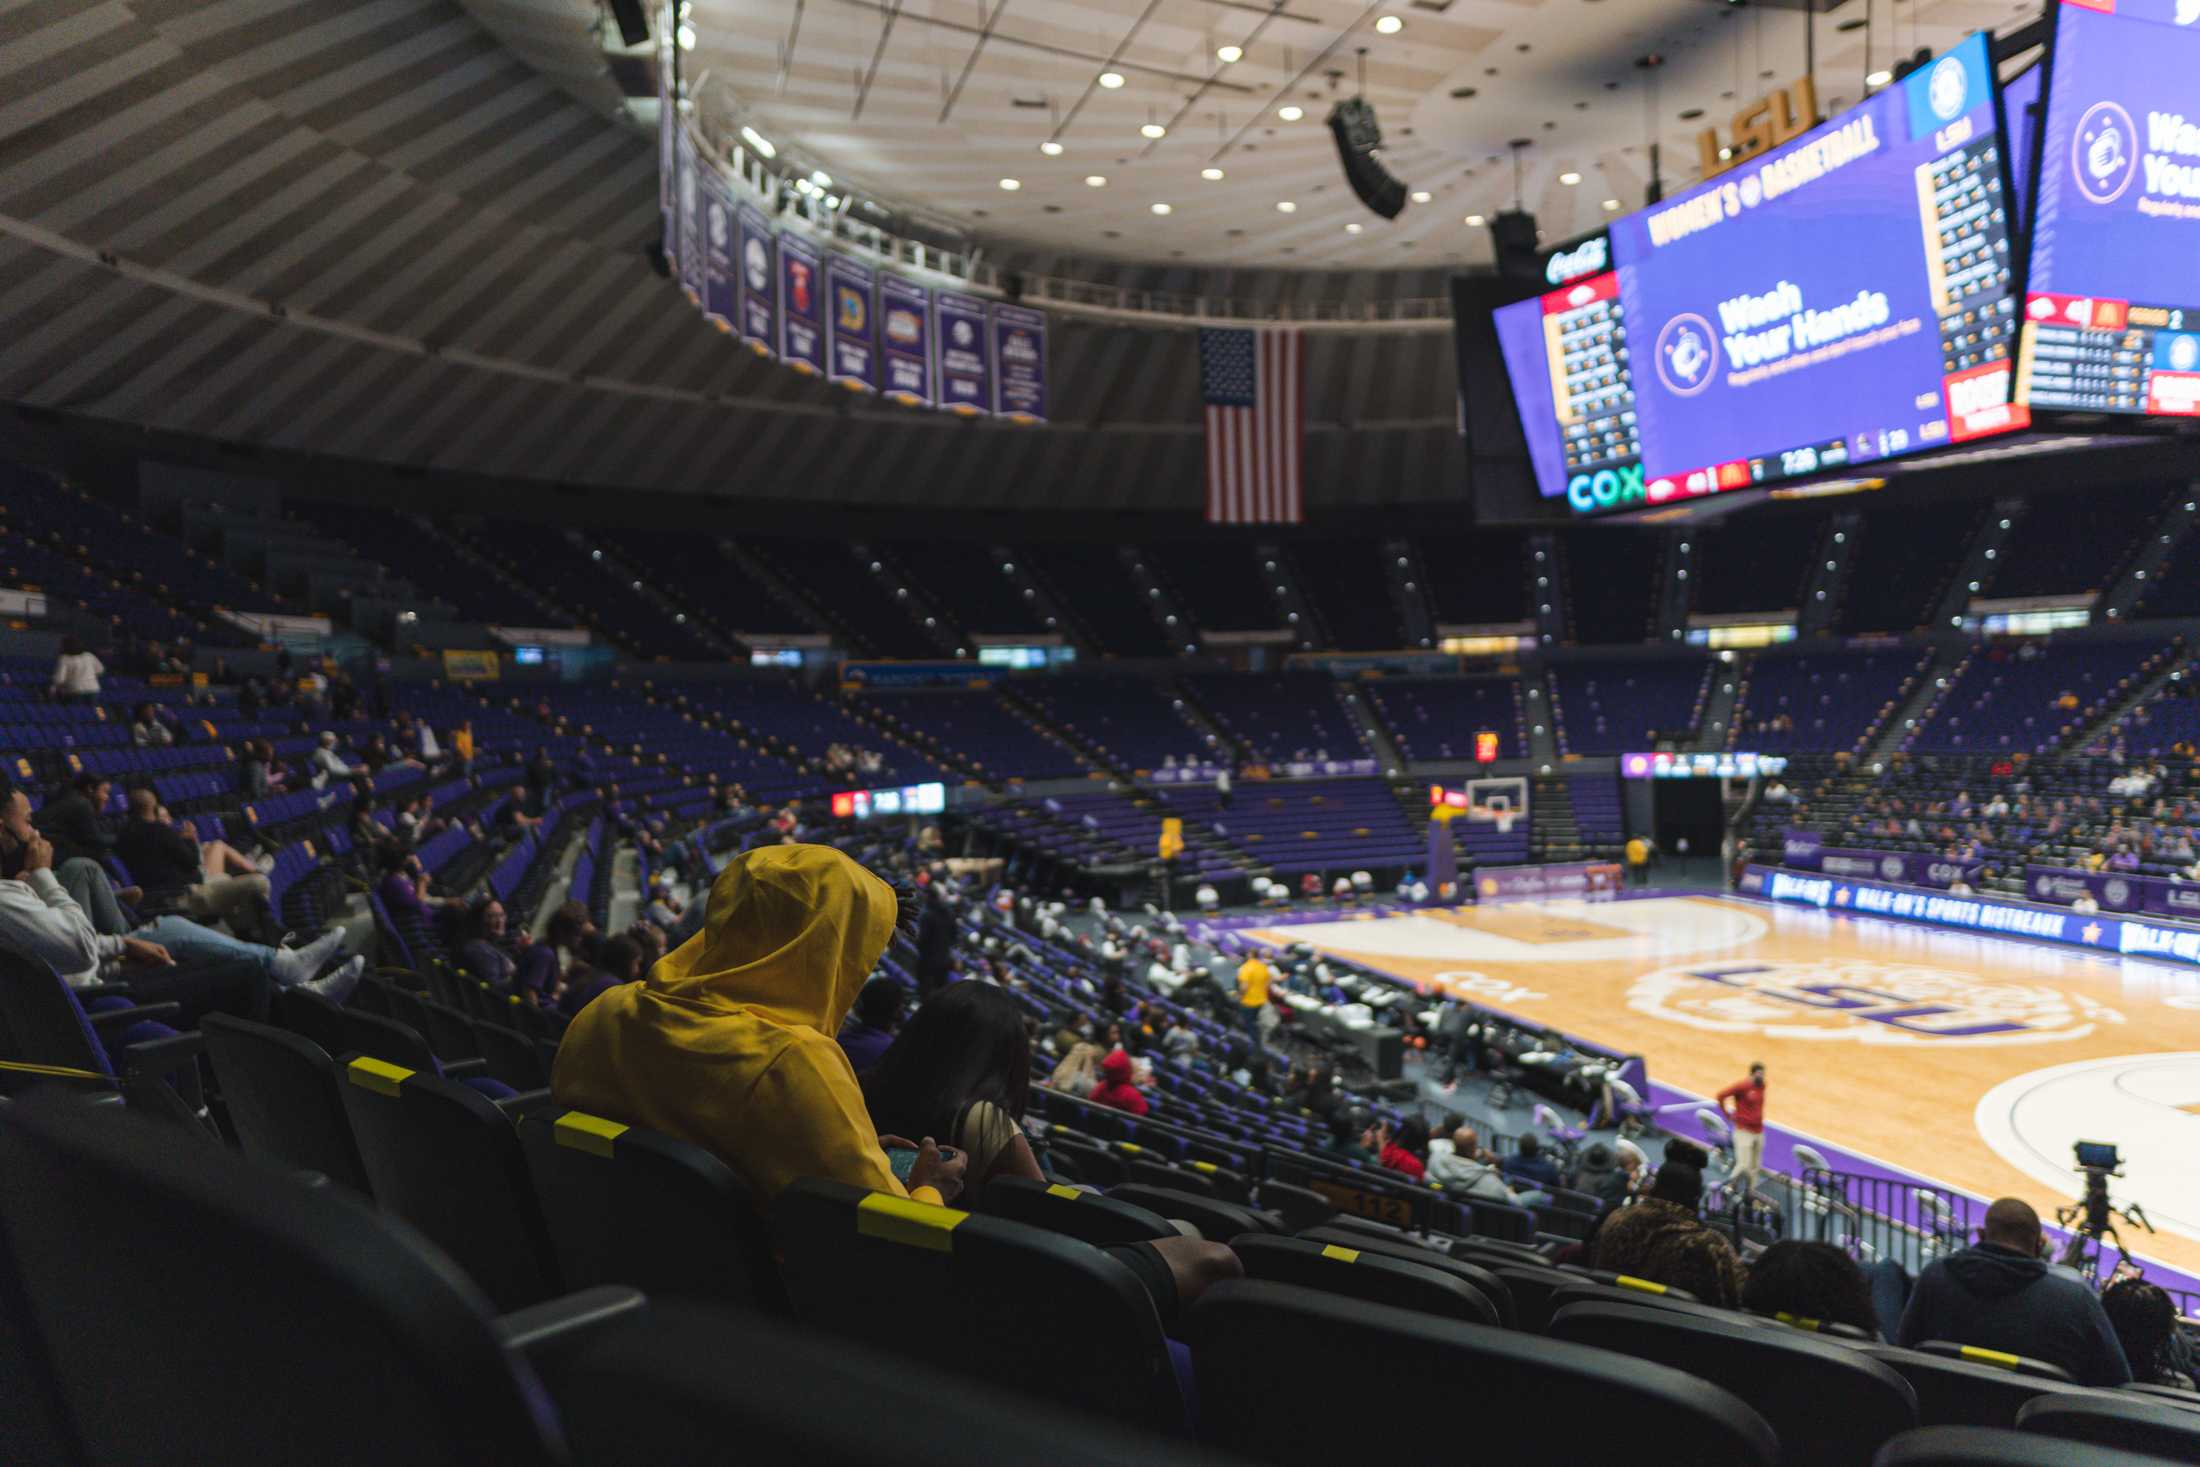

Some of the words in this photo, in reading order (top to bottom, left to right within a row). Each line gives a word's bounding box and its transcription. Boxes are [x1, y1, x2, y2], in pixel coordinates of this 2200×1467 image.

[1697, 75, 1816, 180] LSU
[2147, 111, 2200, 156] Wa
[1648, 182, 1740, 246] WOMEN'S
[1760, 113, 1879, 200] BASKETBALL
[1718, 280, 1802, 333] Wash
[1723, 324, 1792, 368] Your
[1792, 290, 1889, 350] Hands
[1567, 463, 1646, 512] COX
[1856, 887, 1927, 917] WALK-ON'S
[1925, 897, 1980, 926] SPORTS
[2120, 921, 2200, 964] WALK-ON
